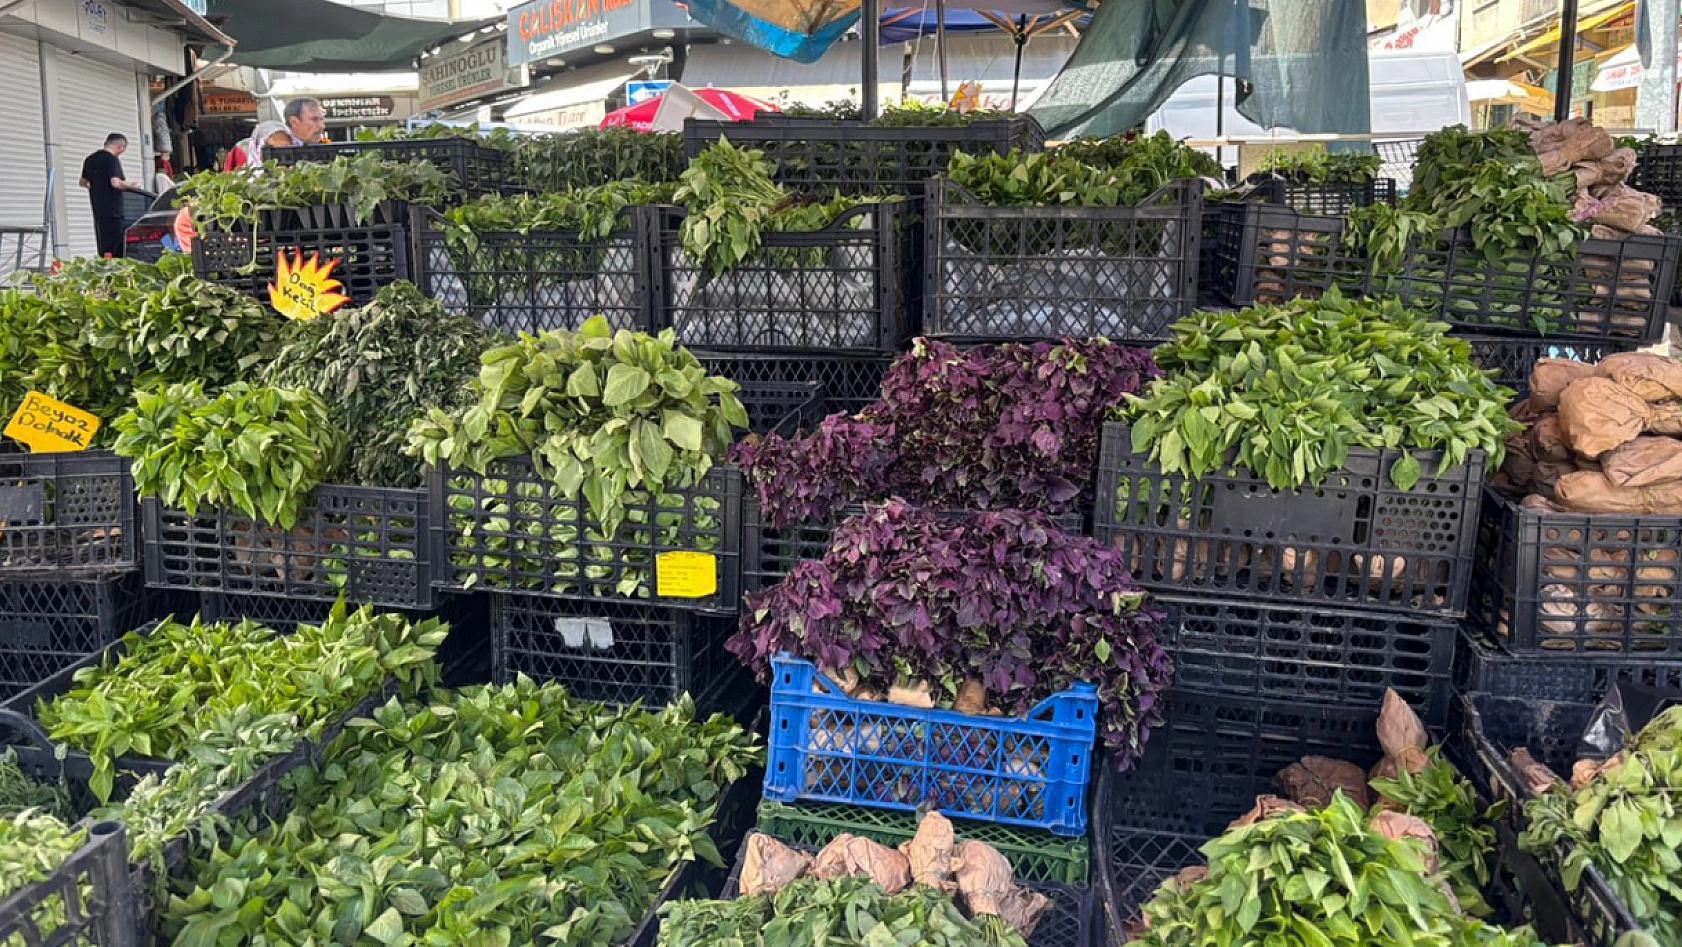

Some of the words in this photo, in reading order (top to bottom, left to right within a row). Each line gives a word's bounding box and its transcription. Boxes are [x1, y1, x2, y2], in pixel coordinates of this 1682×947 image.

[529, 35, 555, 55] Organik
[556, 26, 580, 47] Yöresel
[580, 19, 609, 39] Ürünler
[422, 47, 496, 84] ŞAHİNOĞLU
[26, 396, 90, 432] Beyaz
